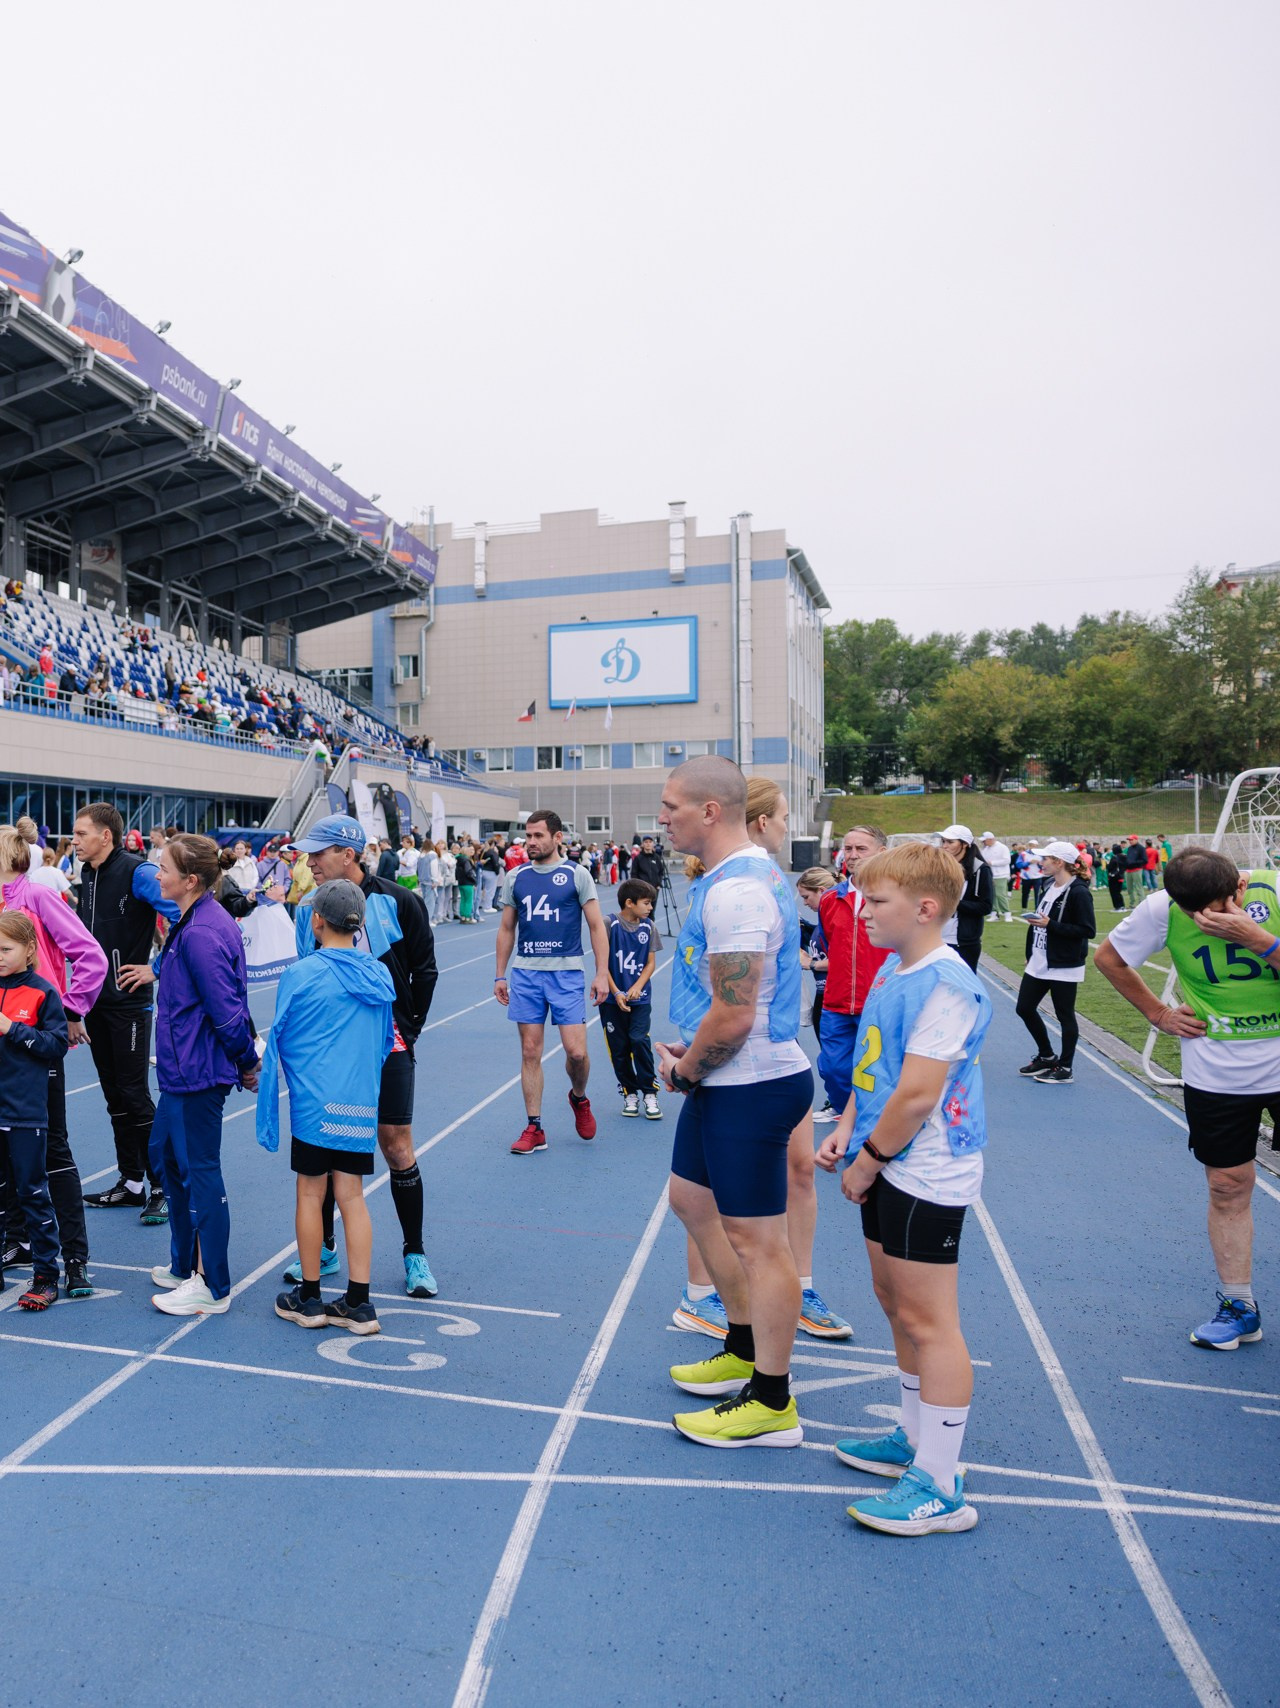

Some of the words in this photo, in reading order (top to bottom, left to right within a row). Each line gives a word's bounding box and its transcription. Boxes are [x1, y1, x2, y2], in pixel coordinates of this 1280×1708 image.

[161, 363, 208, 408] psbank.ru
[534, 941, 563, 949] КОМОС
[1233, 1012, 1280, 1027] КОМ
[852, 1024, 883, 1093] 2
[908, 1498, 946, 1521] HOKA
